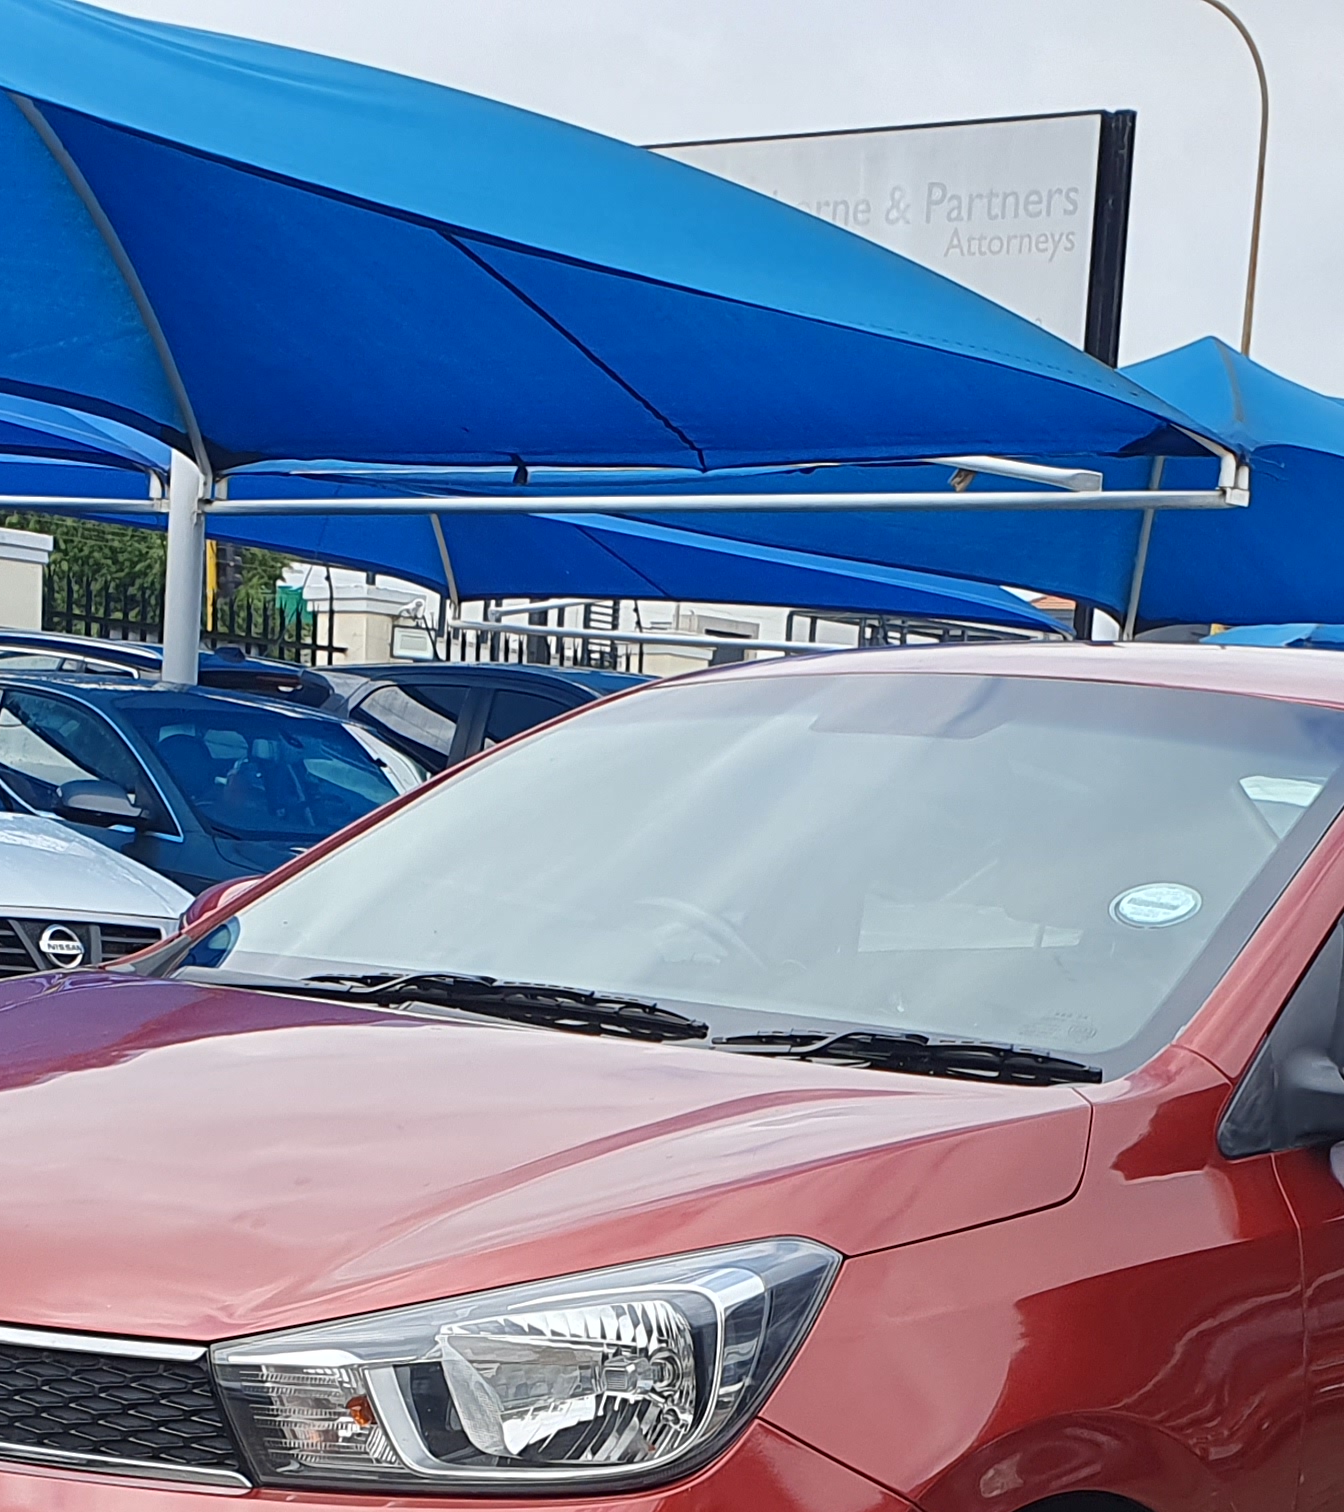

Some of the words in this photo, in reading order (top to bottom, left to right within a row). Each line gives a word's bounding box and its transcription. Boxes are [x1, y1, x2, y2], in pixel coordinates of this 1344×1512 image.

[884, 185, 911, 226] &
[925, 182, 1080, 224] Partners
[944, 227, 1076, 263] Attorneys
[47, 943, 82, 952] NISSAN
